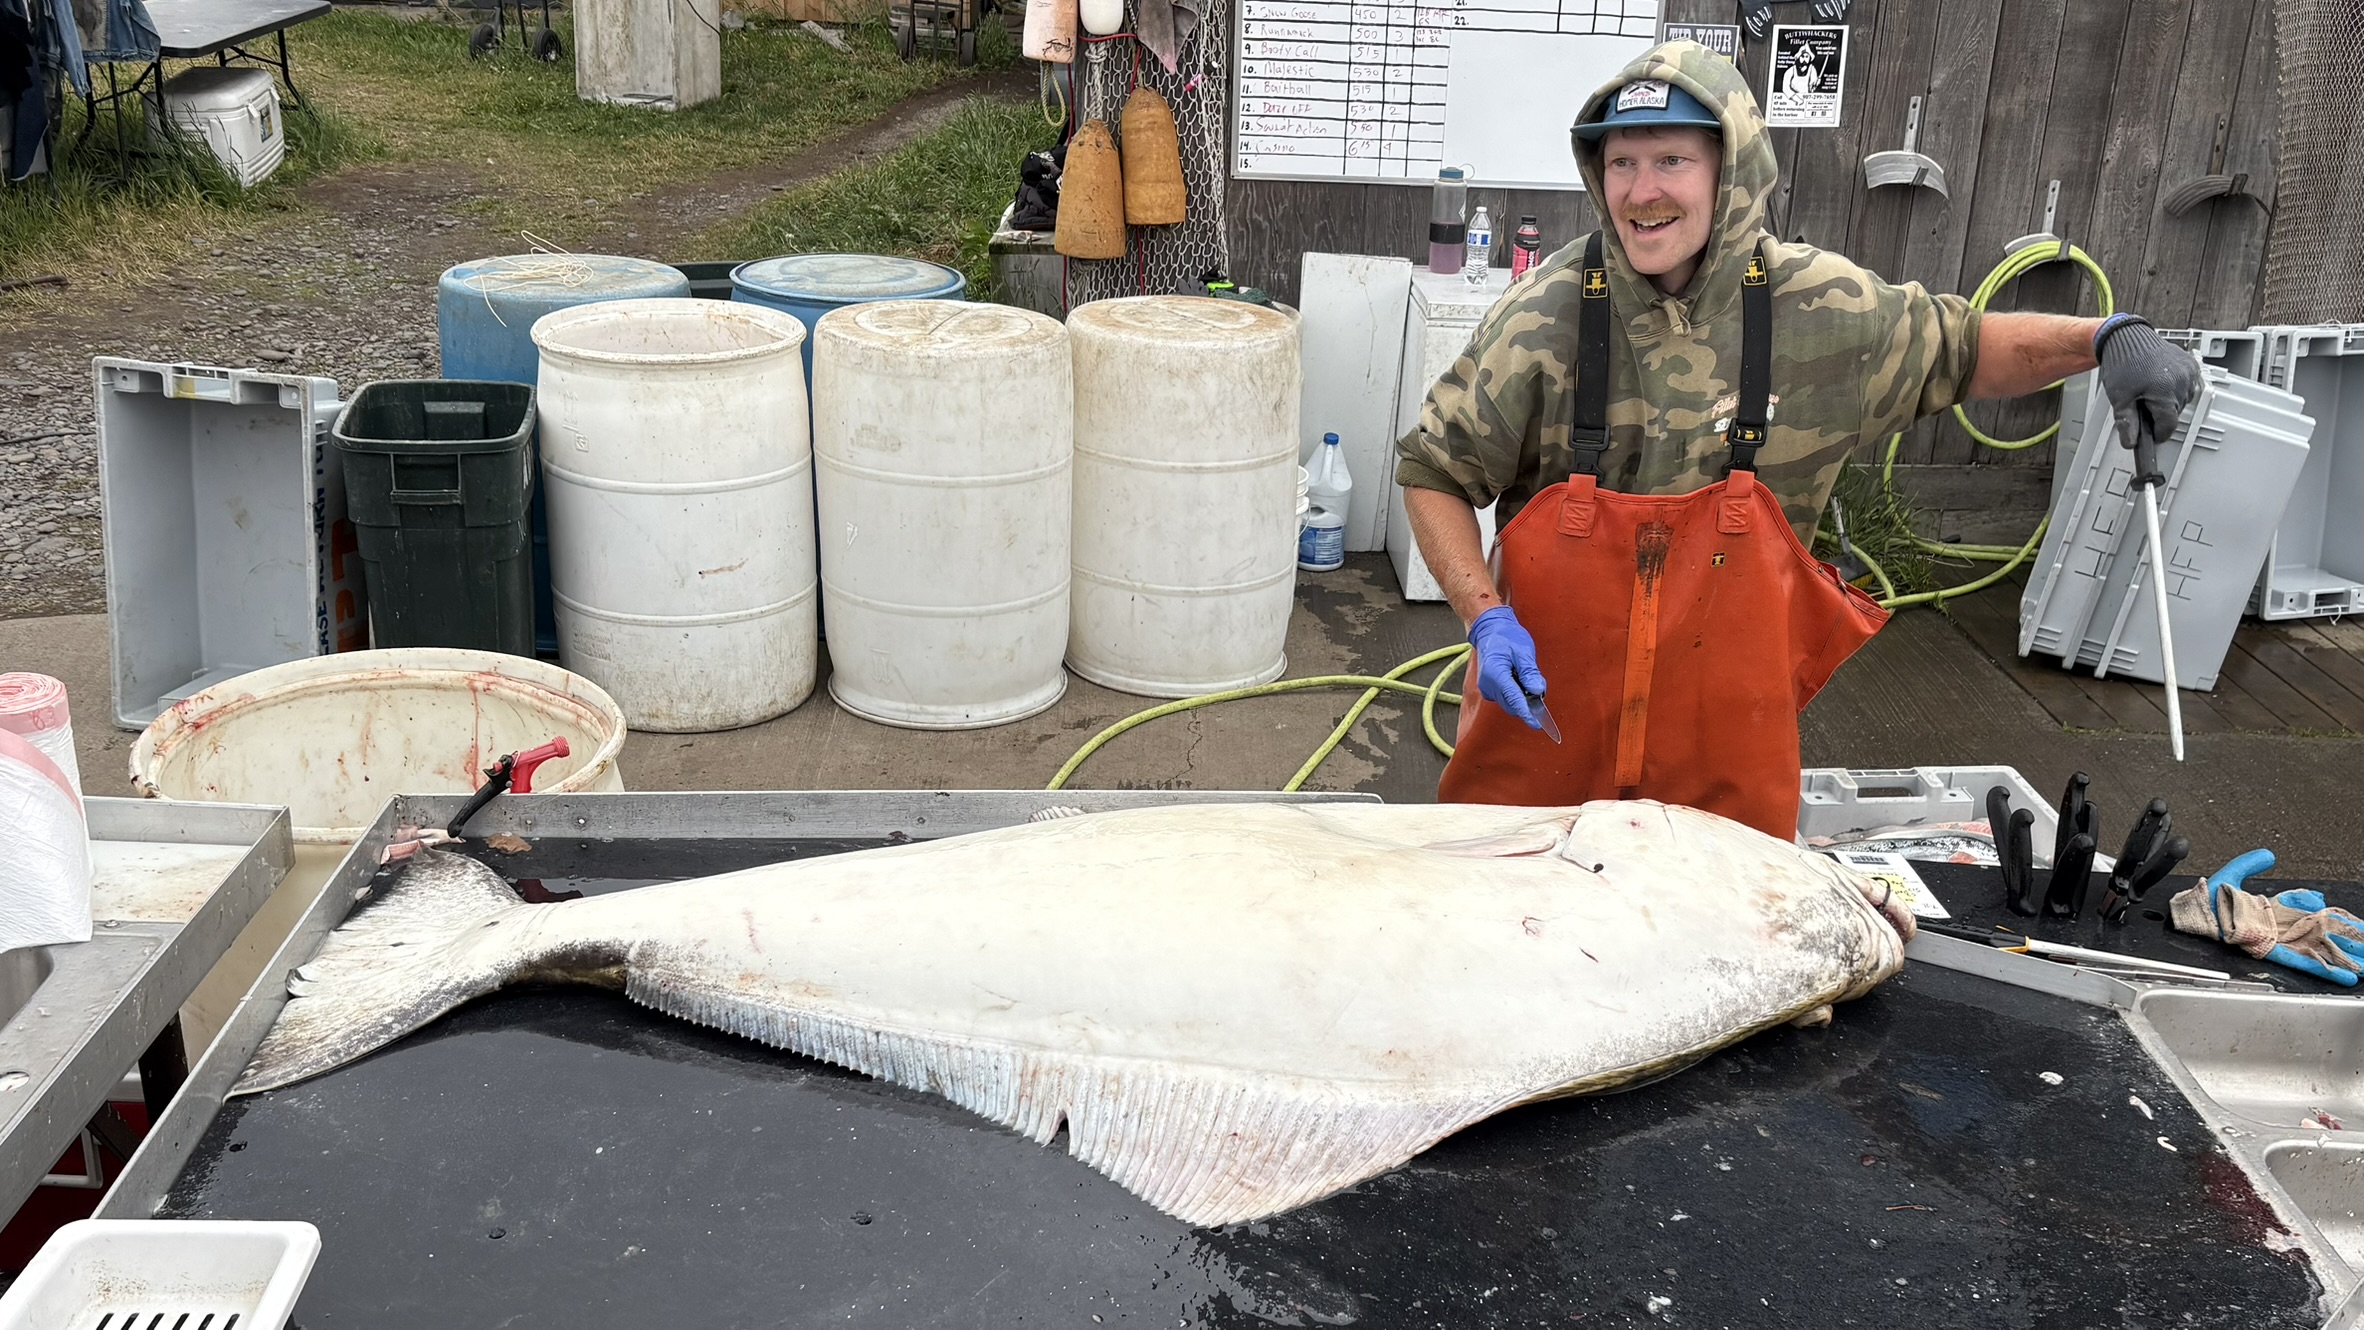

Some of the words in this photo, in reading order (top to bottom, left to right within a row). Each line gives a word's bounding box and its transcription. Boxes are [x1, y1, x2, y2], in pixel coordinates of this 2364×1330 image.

[1245, 5, 1255, 15] 7.
[1354, 8, 1376, 20] 450
[1394, 9, 1406, 20] 2
[1454, 15, 1470, 26] 22.
[1244, 23, 1253, 34] 8.
[1354, 27, 1377, 40] 500
[1394, 30, 1404, 42] 3
[1695, 28, 1732, 53] YOUR
[1244, 43, 1254, 54] 9.
[1354, 46, 1379, 59] 515
[1243, 64, 1257, 74] 10.
[1353, 67, 1379, 78] 530
[1392, 69, 1404, 78] 2
[1242, 84, 1252, 94] 11.
[1352, 85, 1371, 97] 515
[1241, 103, 1256, 113] 12.
[1350, 104, 1374, 117] 530
[1389, 106, 1402, 116] 2
[1240, 120, 1254, 131] 13.
[1239, 140, 1252, 151] 14.
[1239, 157, 1252, 168] 15.
[2164, 519, 2214, 601] HFP
